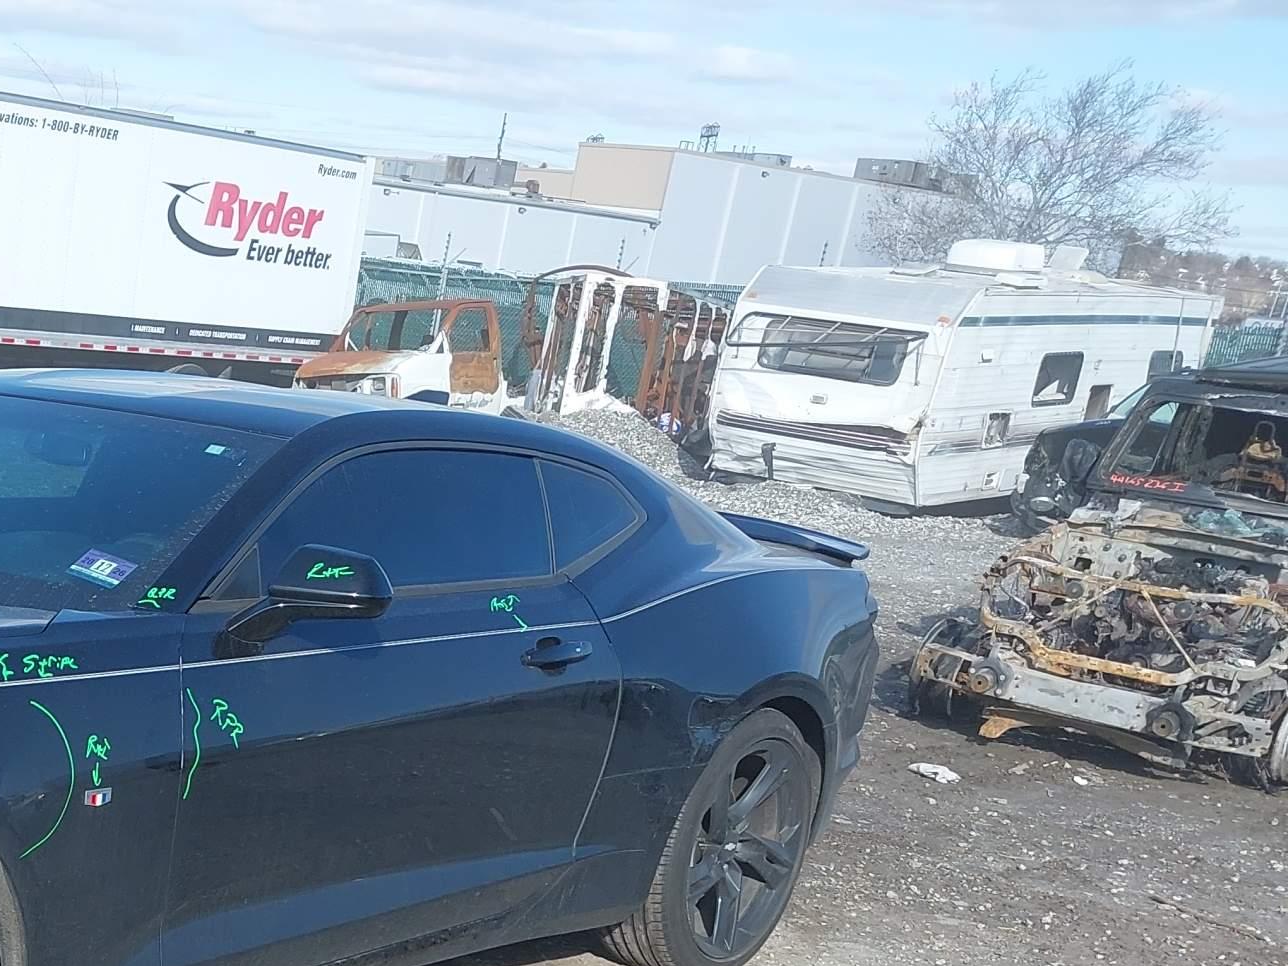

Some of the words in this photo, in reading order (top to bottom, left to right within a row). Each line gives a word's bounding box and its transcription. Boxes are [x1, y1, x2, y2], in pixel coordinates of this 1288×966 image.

[41, 118, 119, 141] 1-800-BY-RYDER
[317, 163, 357, 180] Ryder.com
[204, 181, 325, 242] Ryder
[246, 239, 283, 263] Ever
[283, 244, 332, 270] better.
[134, 325, 166, 334] MAINTENANCE
[188, 328, 212, 338] DEDICATED
[212, 331, 247, 340] TRANSPORTATION
[268, 335, 282, 343] SUPPLY
[295, 337, 321, 346] MANAGEMENT
